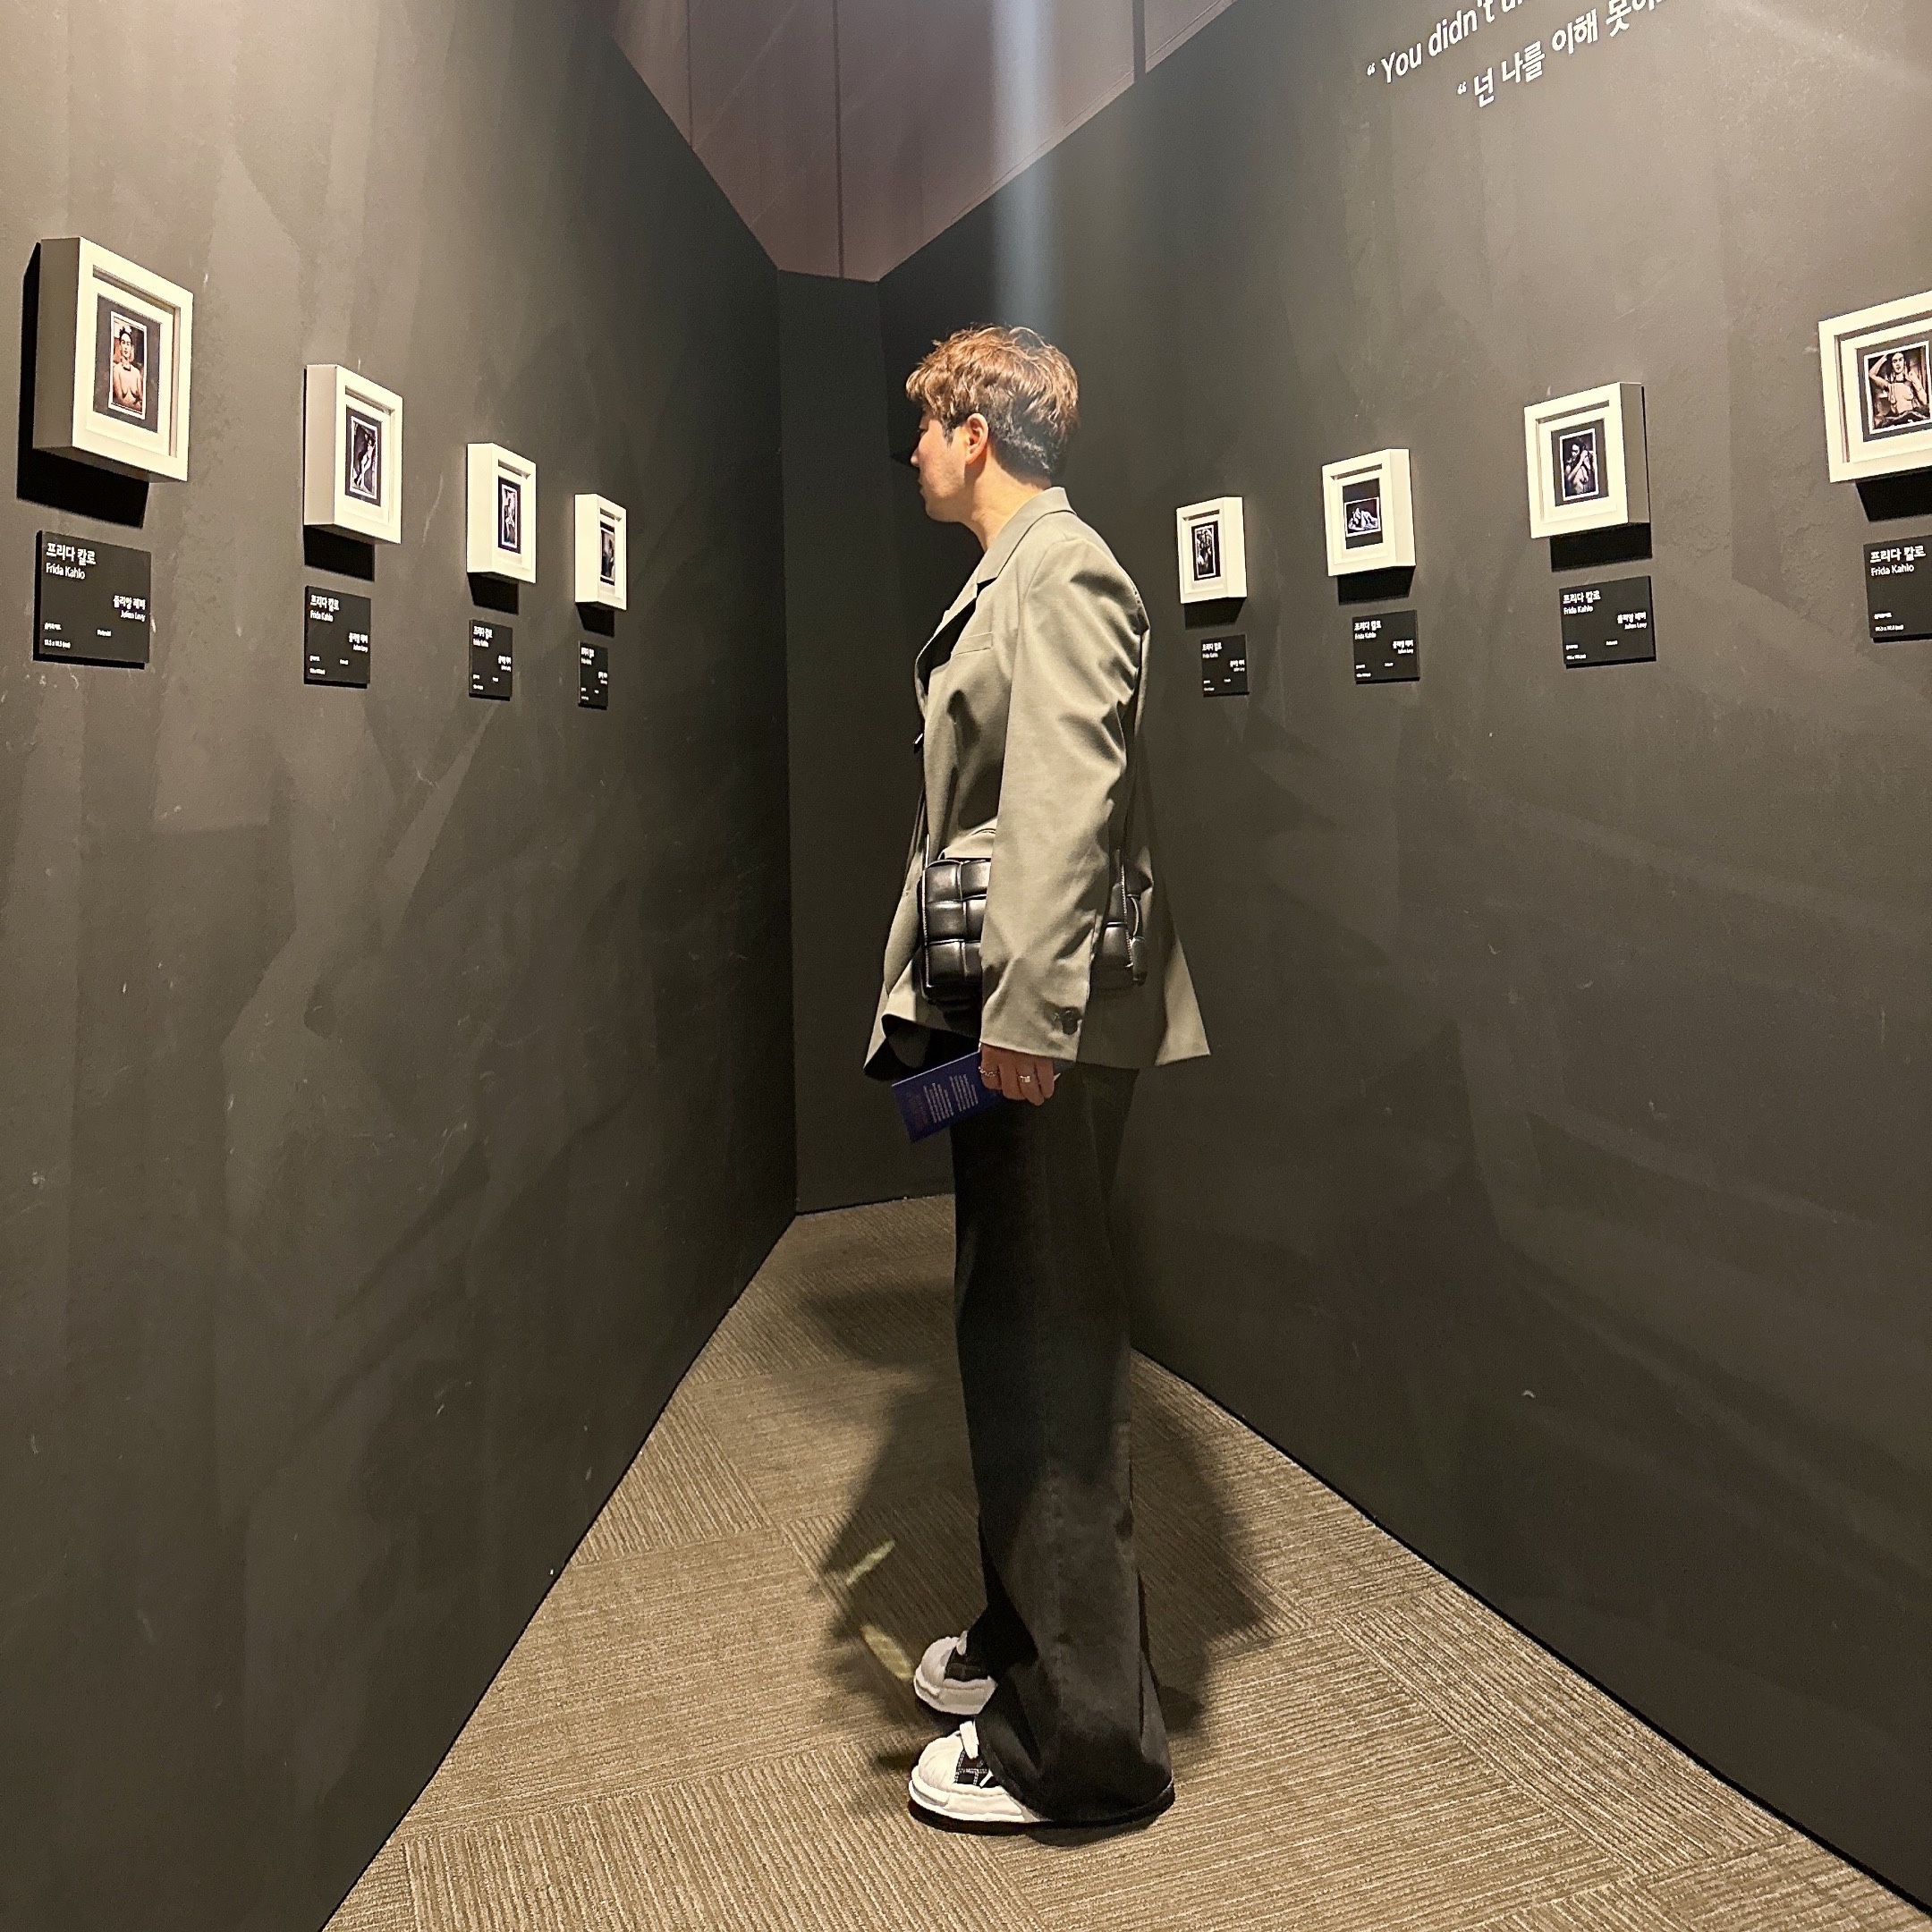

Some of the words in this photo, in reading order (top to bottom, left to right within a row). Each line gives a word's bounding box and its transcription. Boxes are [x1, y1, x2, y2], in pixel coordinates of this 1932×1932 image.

[1381, 43, 1422, 84] You
[1474, 67, 1495, 107] 넌
[1501, 40, 1546, 83] 나를
[1552, 8, 1598, 55] 이해
[46, 542, 76, 562] 프리다
[77, 548, 97, 566] 칼로
[1869, 547, 1902, 564] 프리다
[1903, 545, 1927, 562] 칼로
[46, 562, 64, 576] Frida
[64, 565, 86, 580] Kahlo
[1870, 565, 1891, 577] Frida
[1891, 563, 1915, 574] Kahlo
